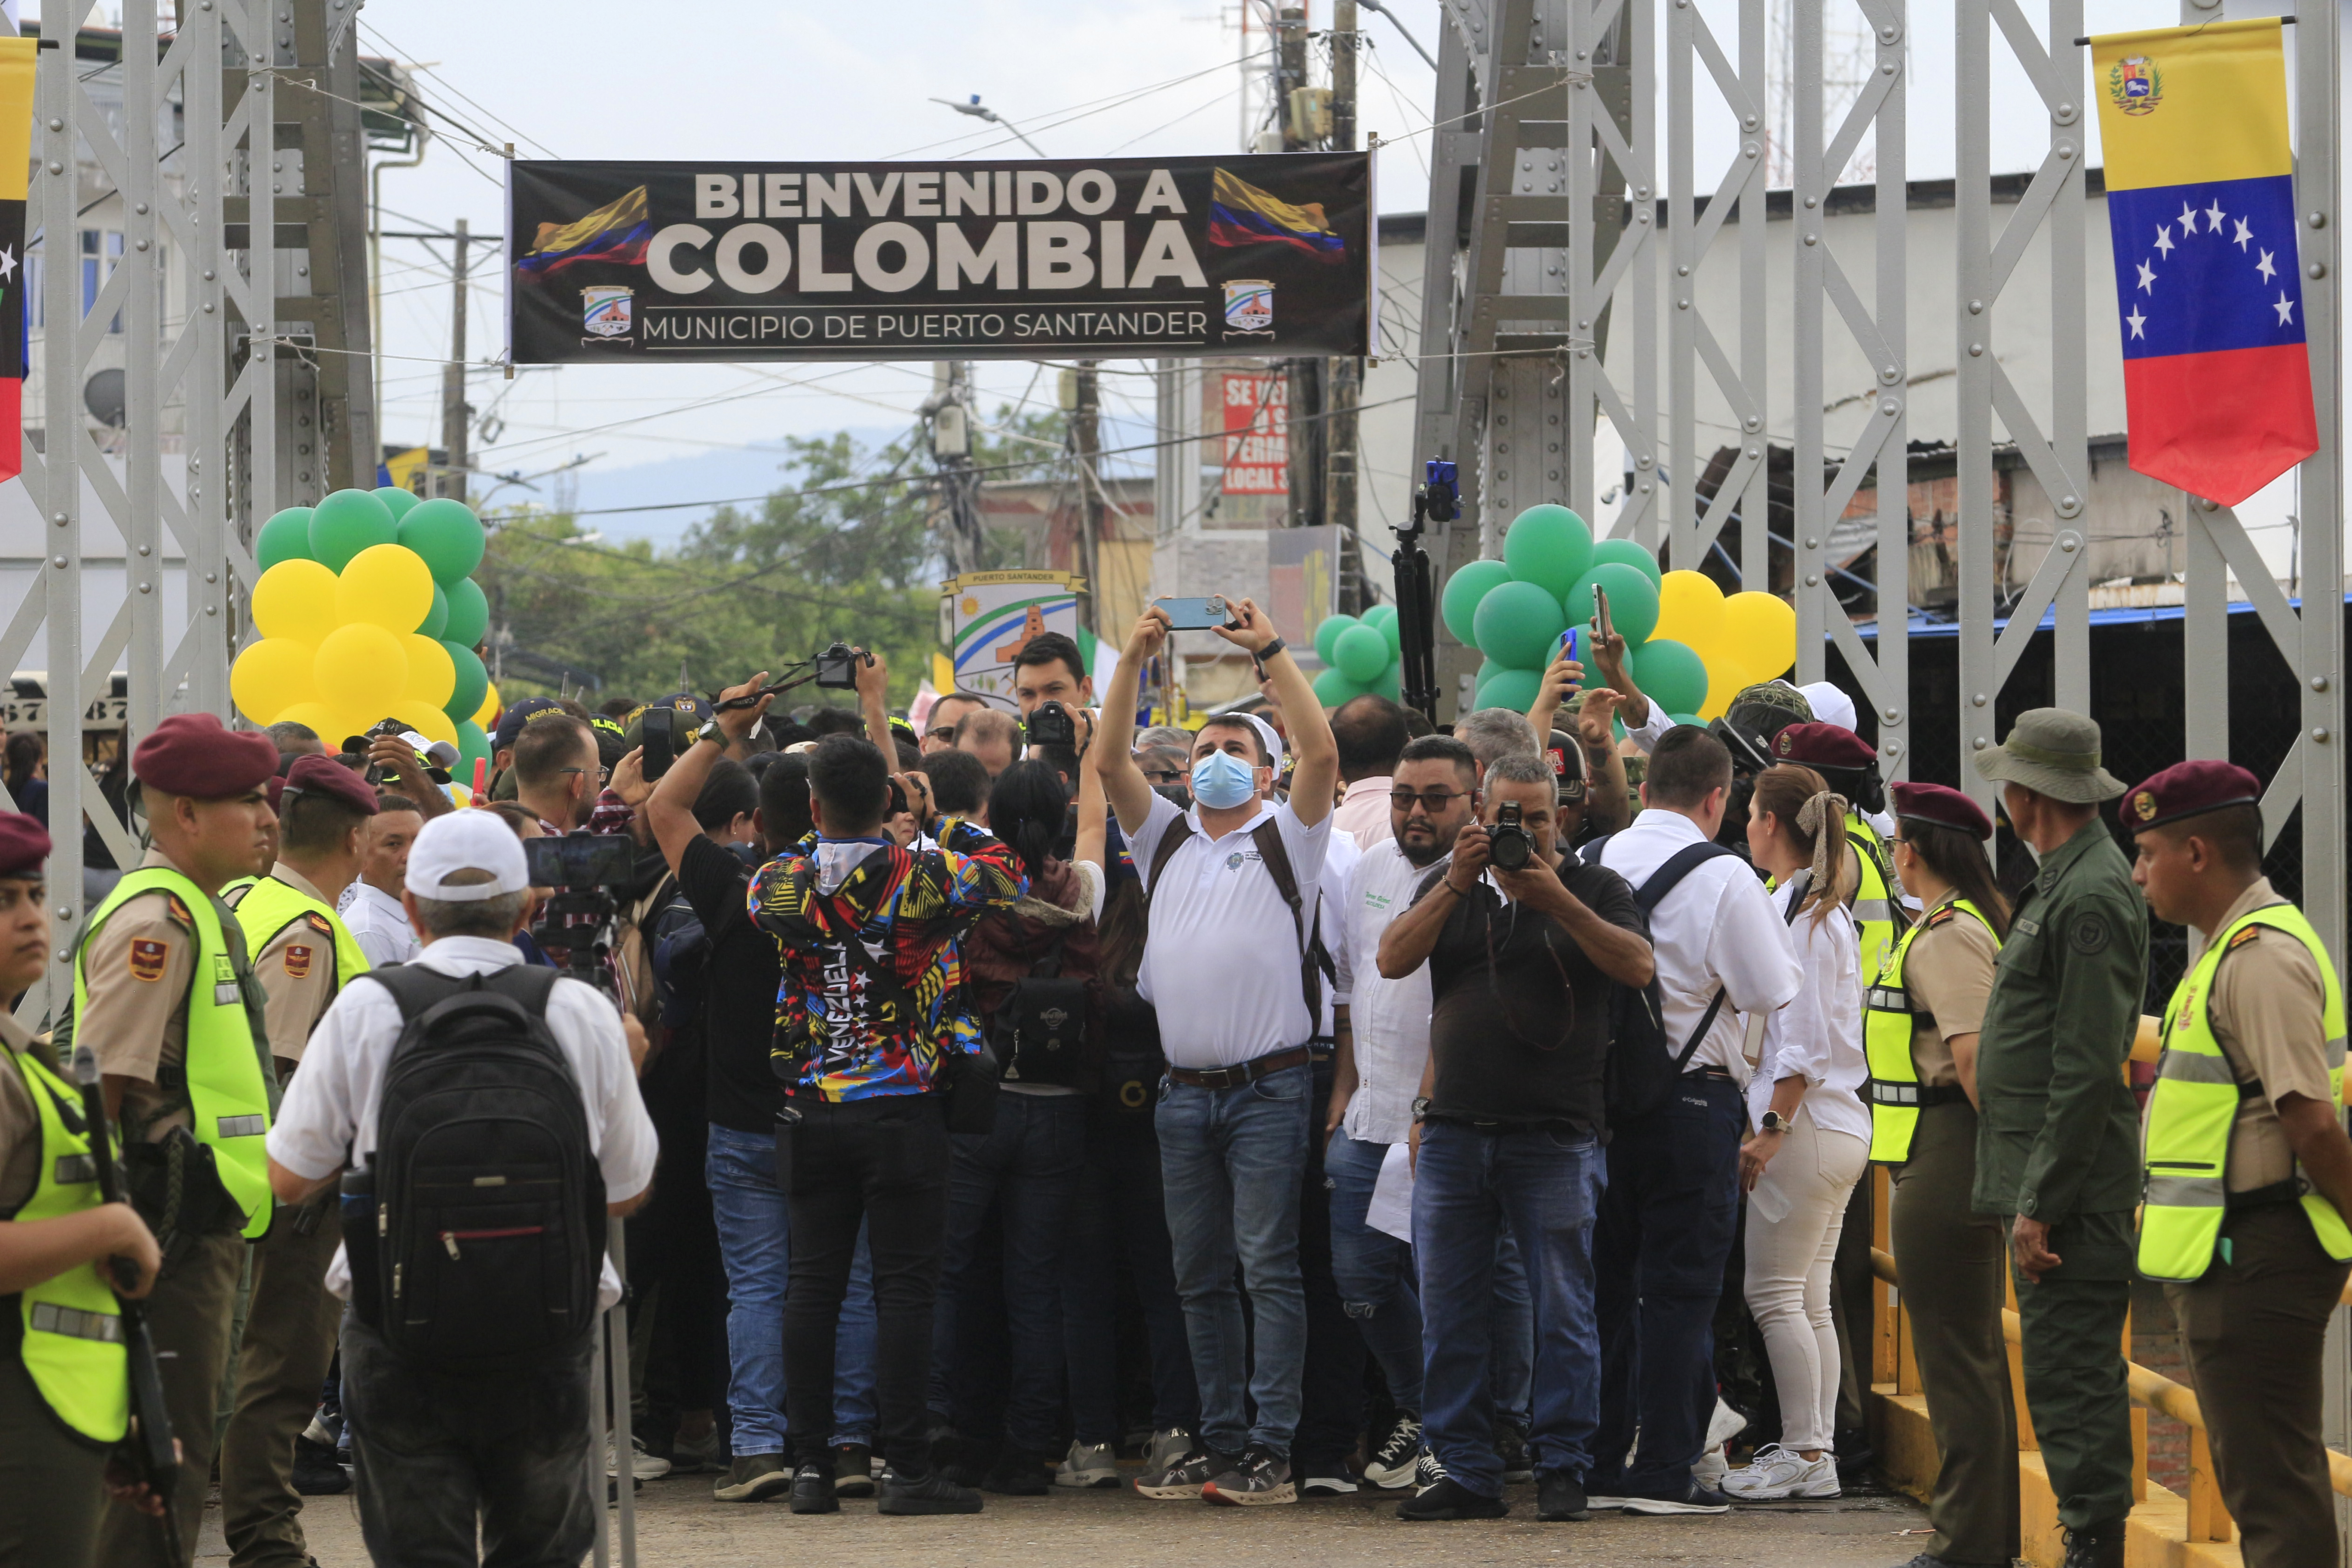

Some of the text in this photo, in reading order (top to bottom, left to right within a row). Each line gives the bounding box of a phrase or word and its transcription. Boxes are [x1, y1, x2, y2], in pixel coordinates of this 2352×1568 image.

[696, 169, 1187, 218] BIENVENIDO A
[646, 220, 1209, 294] COLOMBIA
[643, 312, 1207, 340] MUNICIPIO DE PUERTO SANTANDER
[1226, 379, 1253, 406] SE
[1225, 467, 1276, 490] LOCAL
[973, 573, 1004, 582] PUERTO
